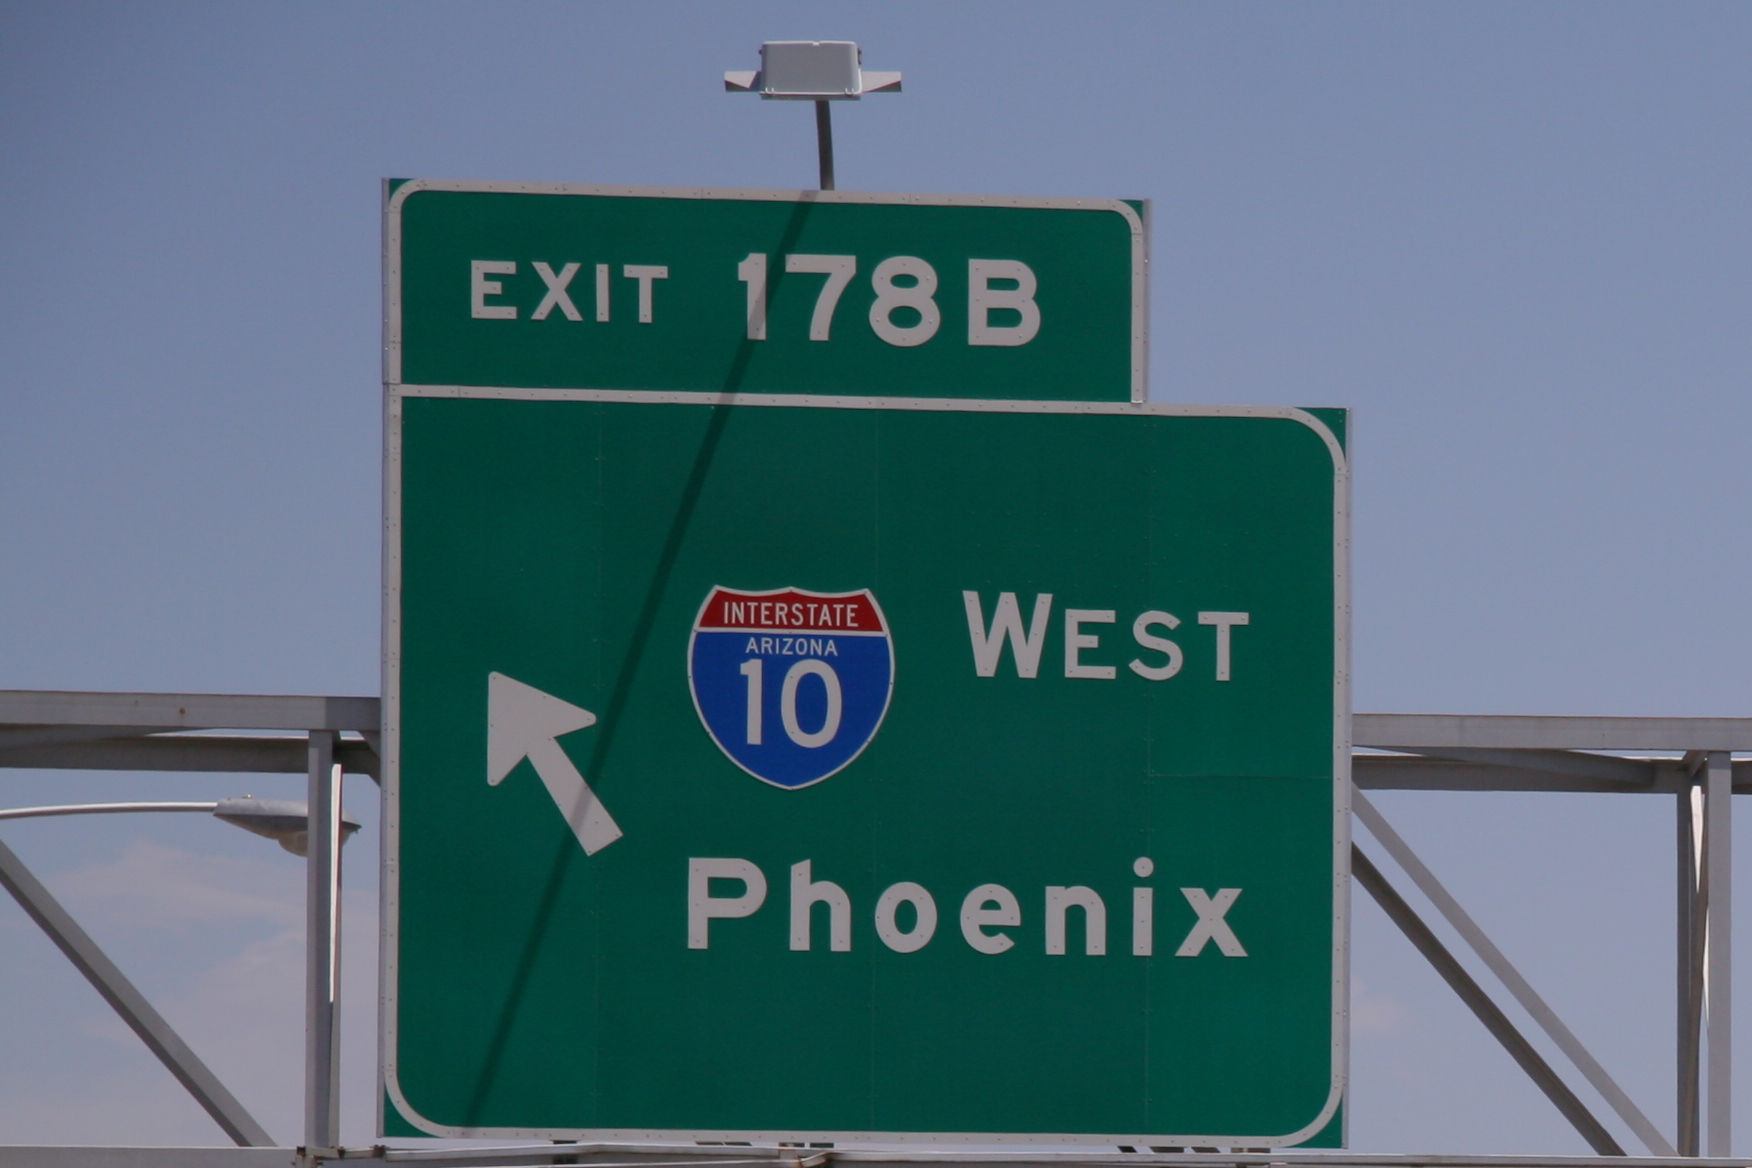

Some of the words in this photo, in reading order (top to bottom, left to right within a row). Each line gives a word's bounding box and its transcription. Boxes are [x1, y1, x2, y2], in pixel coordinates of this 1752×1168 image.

[471, 260, 668, 323] EXIT
[738, 253, 1041, 347] 178B
[723, 601, 859, 627] INTERSTATE
[745, 637, 838, 657] ARIZONA
[963, 591, 1249, 681] WEST
[740, 659, 842, 748] 10
[688, 857, 1248, 957] Phoenix
